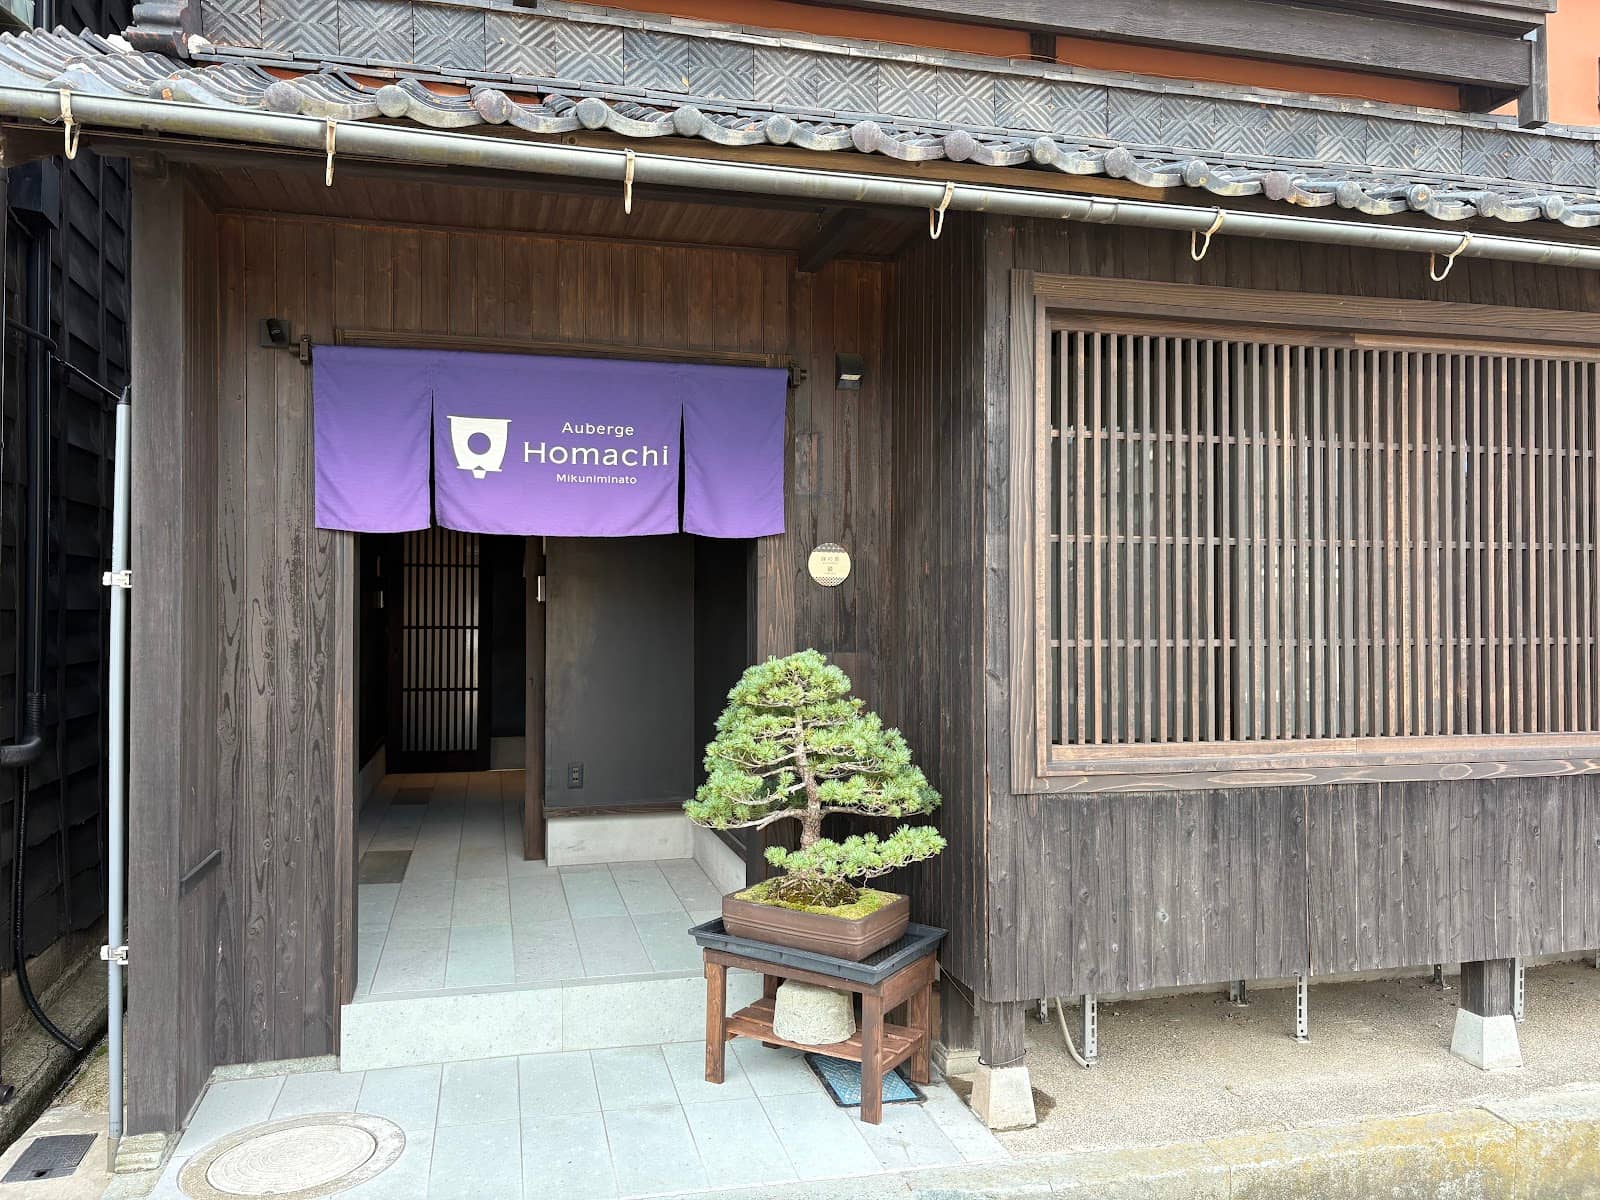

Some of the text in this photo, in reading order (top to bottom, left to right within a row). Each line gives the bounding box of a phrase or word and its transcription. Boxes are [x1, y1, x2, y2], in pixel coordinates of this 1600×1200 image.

[561, 421, 635, 438] Auberge
[523, 441, 669, 467] Homachi
[556, 473, 638, 485] Mikuniminato
